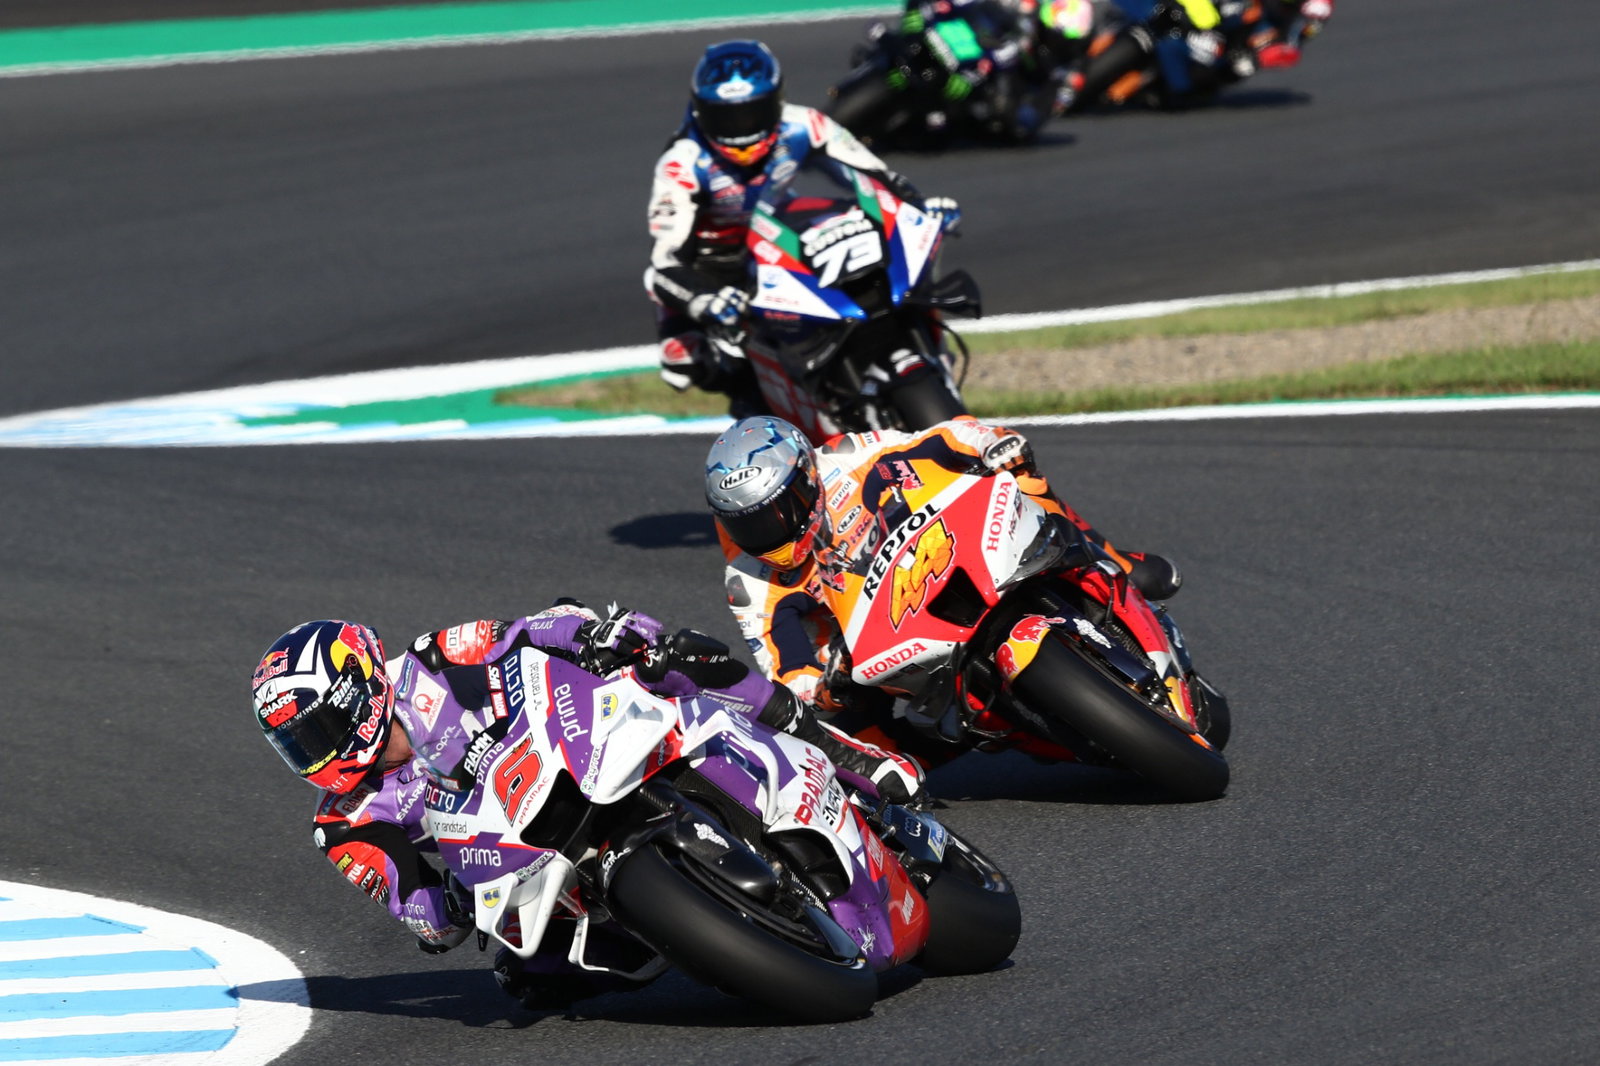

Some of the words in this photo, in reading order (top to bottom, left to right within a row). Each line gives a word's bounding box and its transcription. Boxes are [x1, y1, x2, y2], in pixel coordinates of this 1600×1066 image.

[812, 230, 883, 289] 73
[724, 469, 754, 488] HJC
[831, 480, 852, 507] REPSOL
[986, 481, 1012, 552] HONDA
[863, 504, 940, 600] REPSOL
[889, 515, 957, 634] 44
[268, 658, 288, 678] Bull
[860, 642, 928, 680] HONDA
[260, 689, 299, 719] SHARK
[294, 696, 323, 721] WINGS
[328, 674, 353, 707] Bihr
[356, 696, 385, 744] Red
[553, 683, 589, 743] prima
[463, 732, 496, 776] FIAMM
[476, 742, 505, 786] prima
[396, 780, 427, 821] SHARK
[518, 775, 551, 826] PRAMAC
[794, 746, 828, 826] PRAMAC
[442, 821, 468, 834] randstad
[459, 847, 502, 870] prima
